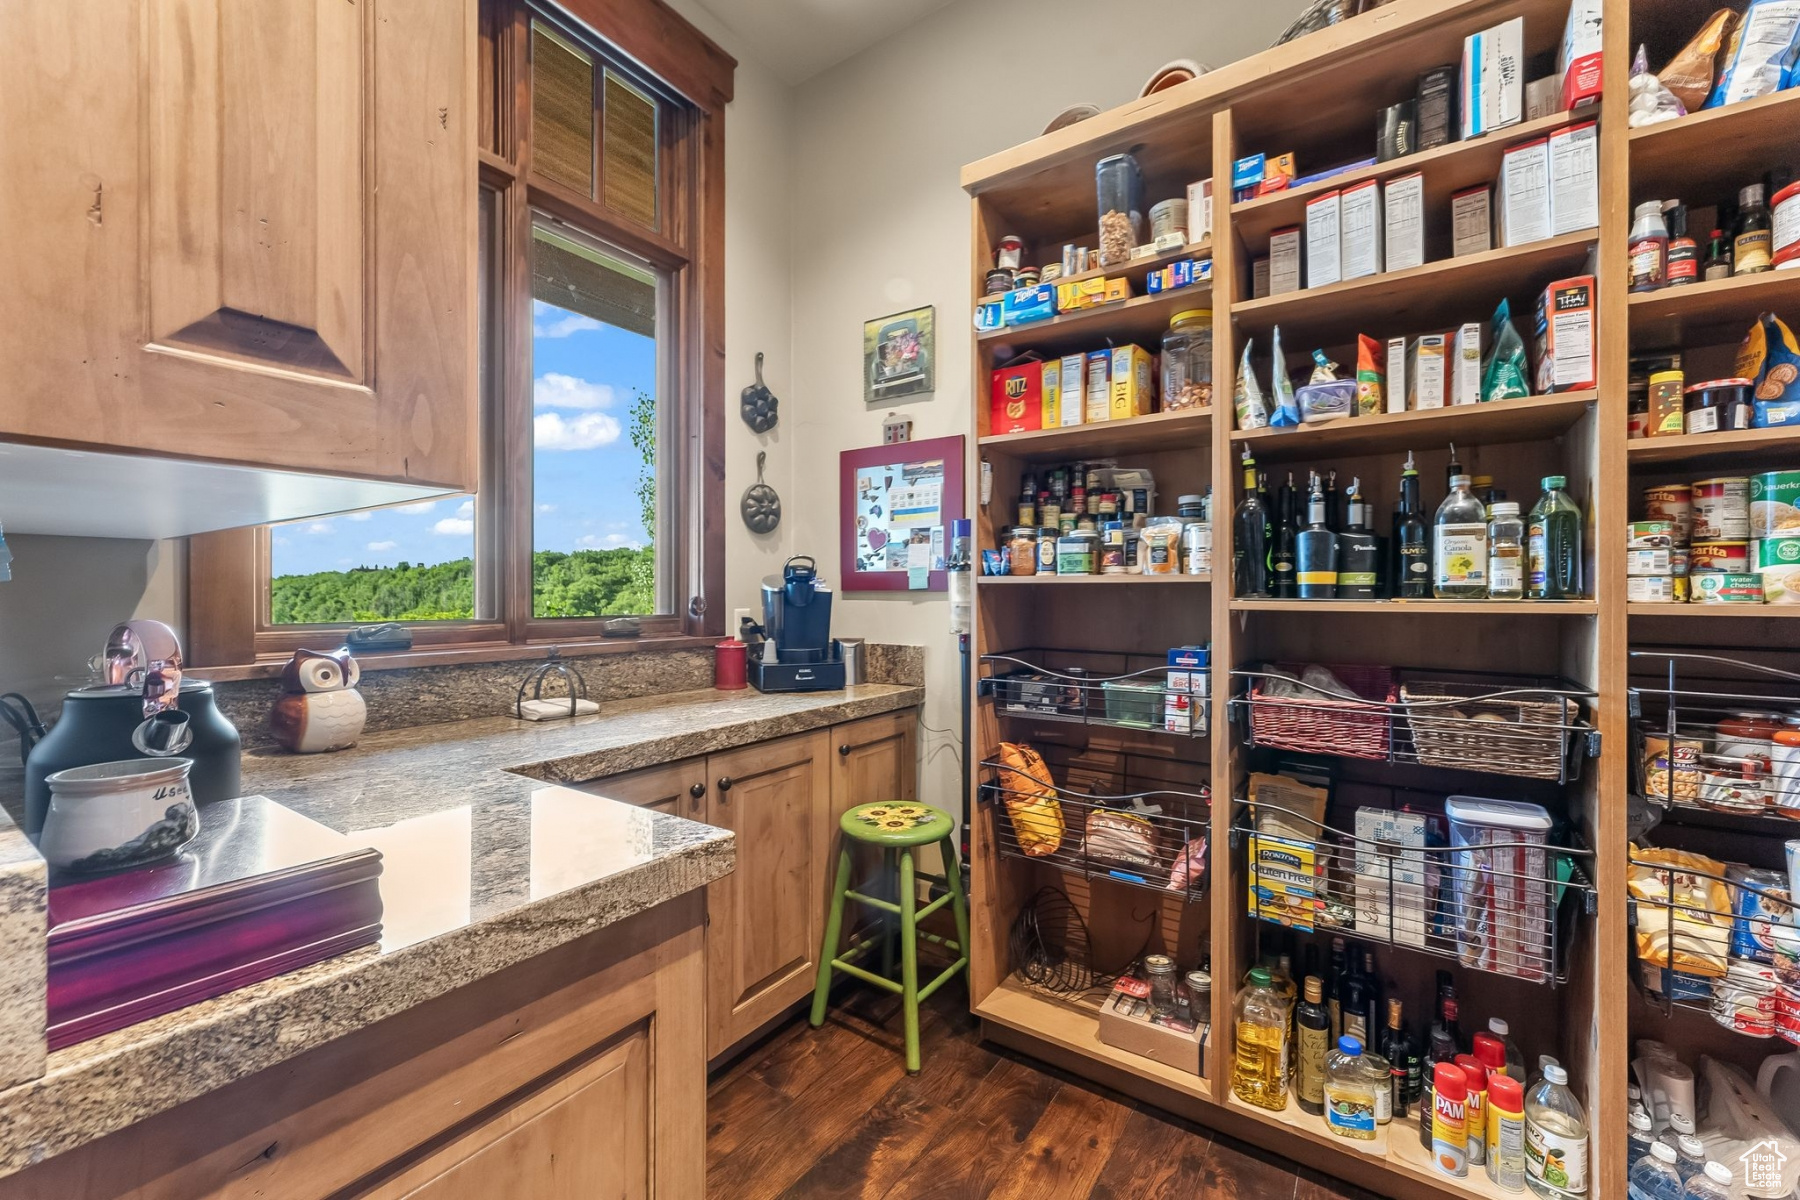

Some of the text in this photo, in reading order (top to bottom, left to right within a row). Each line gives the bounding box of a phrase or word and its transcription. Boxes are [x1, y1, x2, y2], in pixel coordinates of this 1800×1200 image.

[1014, 287, 1040, 304] Ziploc
[1556, 294, 1586, 305] THAI
[1006, 377, 1028, 396] RITZ
[1115, 381, 1127, 409] BIG
[1782, 545, 1799, 553] food
[1091, 820, 1152, 838] SEA SALT
[1288, 872, 1312, 884] Free
[1436, 1095, 1464, 1119] PAM
